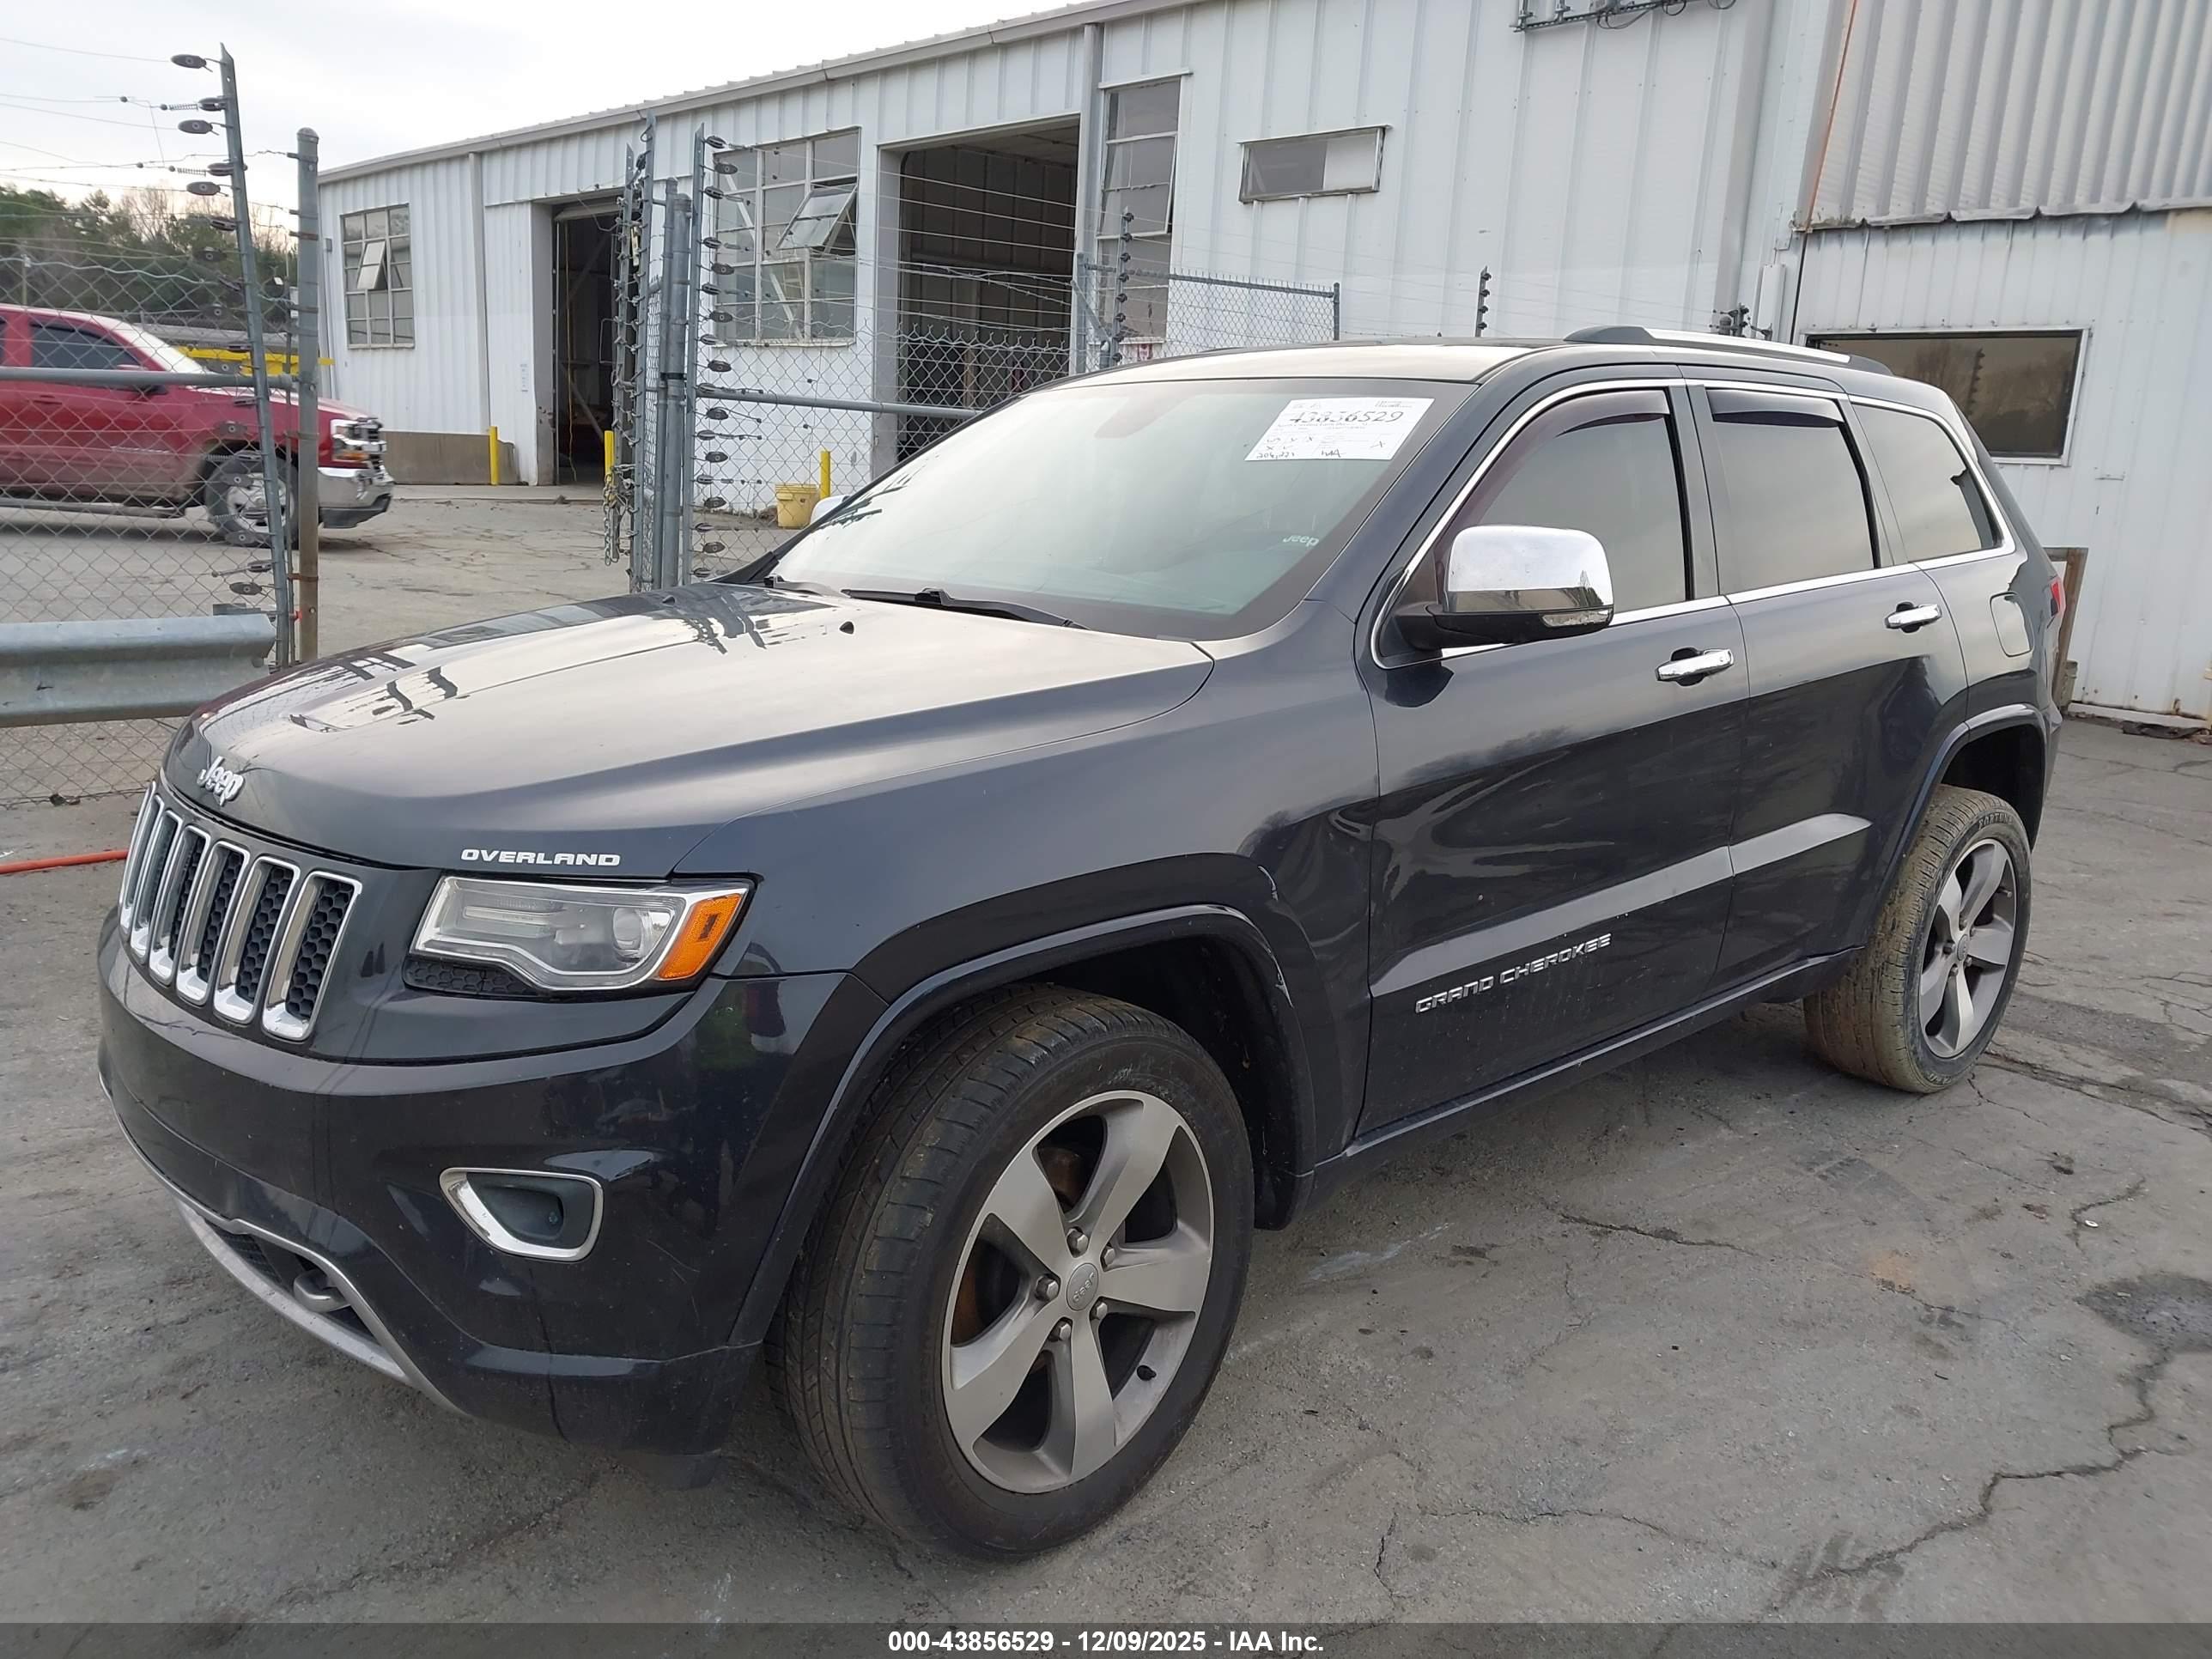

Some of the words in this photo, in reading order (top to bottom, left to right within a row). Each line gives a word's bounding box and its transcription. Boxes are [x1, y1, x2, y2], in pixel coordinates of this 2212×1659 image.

[1282, 534, 1320, 548] Jeep
[197, 756, 245, 806] Jeep
[460, 848, 622, 866] OVERLAND
[1414, 975, 1495, 1013] GRAND
[1499, 933, 1613, 984] CHEROKEE
